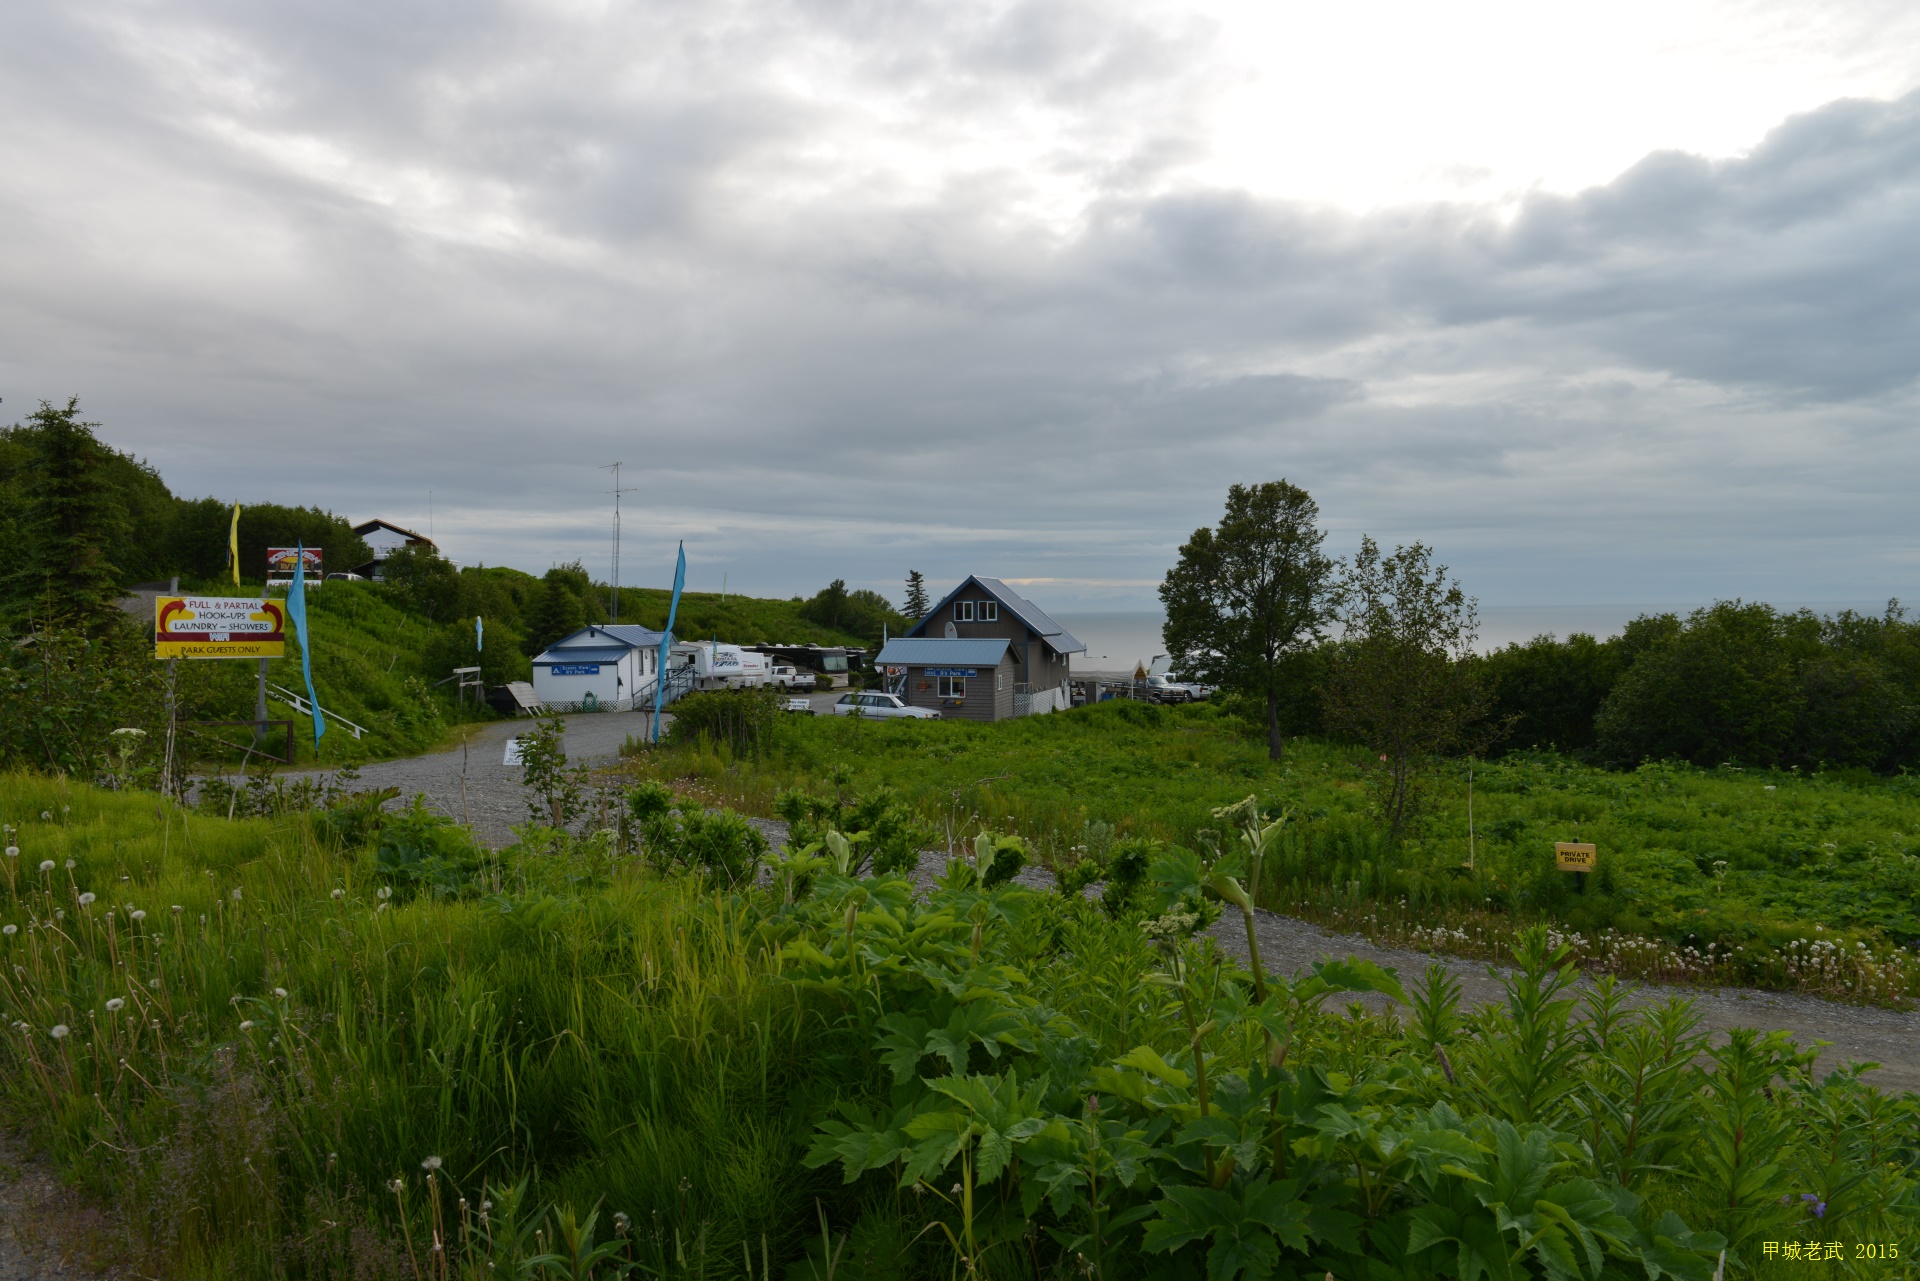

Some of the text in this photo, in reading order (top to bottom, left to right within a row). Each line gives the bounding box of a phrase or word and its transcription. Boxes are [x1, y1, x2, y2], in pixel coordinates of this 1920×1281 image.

[189, 600, 259, 610] FULL & PARTIAL
[199, 611, 246, 620] HOOK-UPS
[229, 623, 268, 631] SHOWERS
[181, 646, 205, 655] PARK
[206, 646, 236, 654] GUESTS
